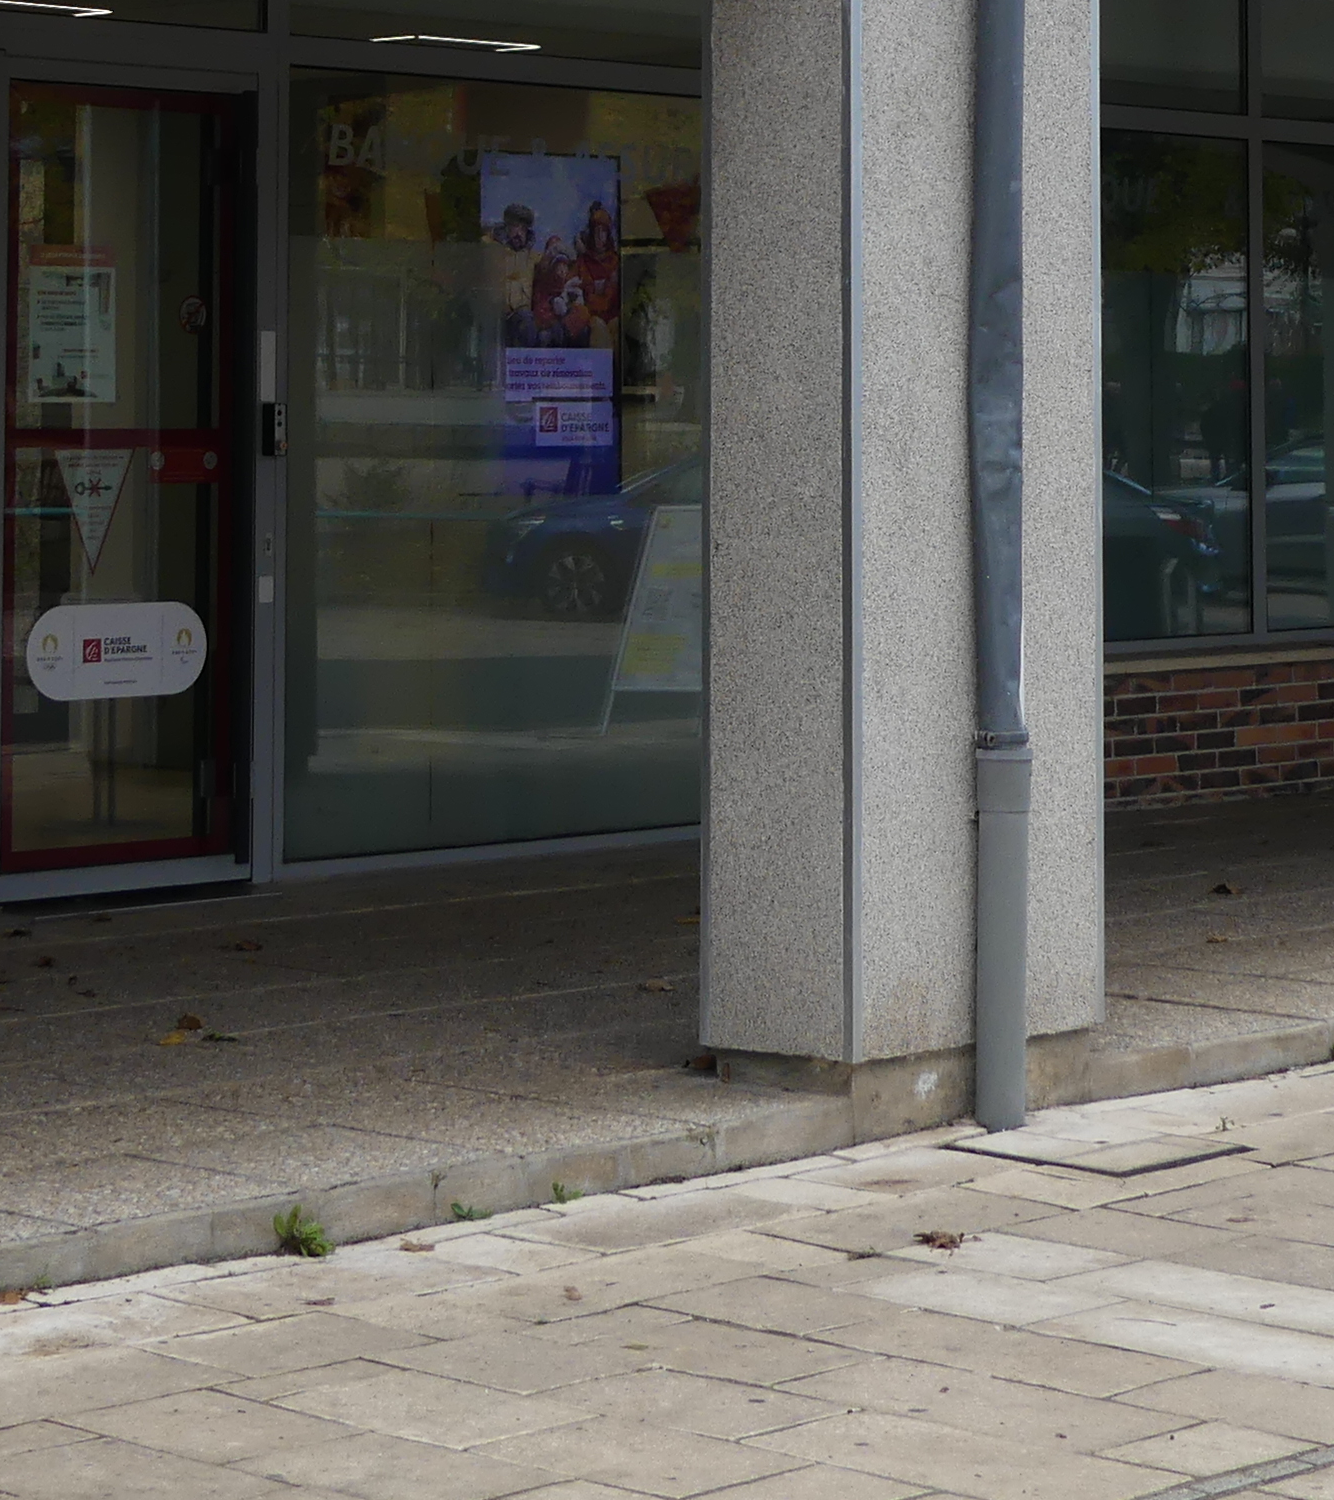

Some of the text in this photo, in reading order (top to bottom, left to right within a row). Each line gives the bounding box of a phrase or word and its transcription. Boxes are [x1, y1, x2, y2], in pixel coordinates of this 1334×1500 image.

[561, 412, 592, 421] CAISSE
[561, 423, 610, 432] D'EPARGNE
[104, 636, 131, 646] CAISSE
[104, 644, 148, 655] D'EPARGNE
